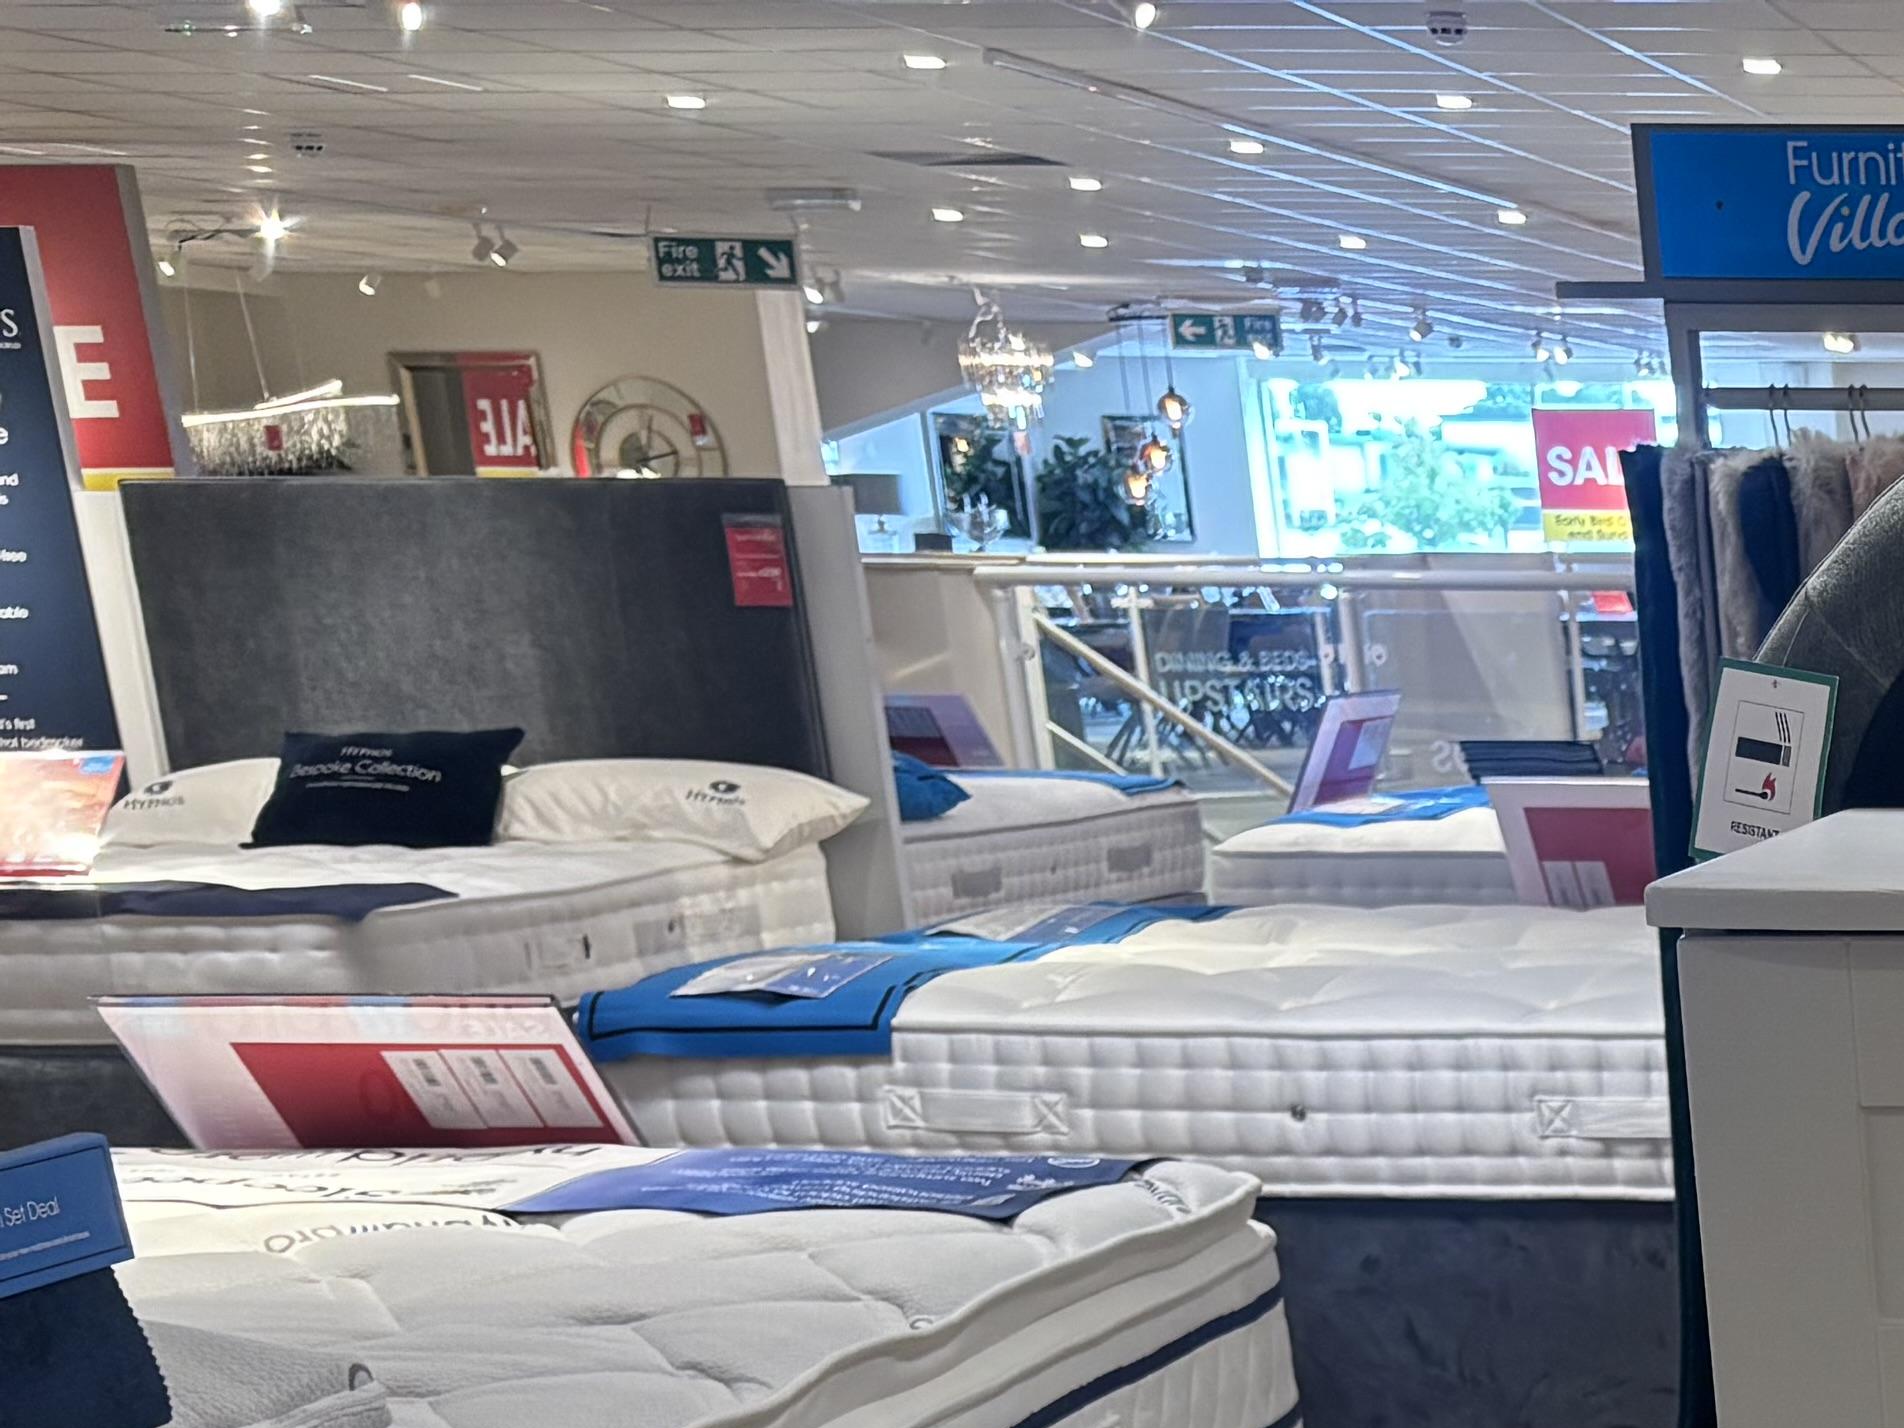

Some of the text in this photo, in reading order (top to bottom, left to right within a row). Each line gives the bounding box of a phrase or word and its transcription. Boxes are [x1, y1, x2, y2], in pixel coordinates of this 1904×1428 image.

[657, 241, 698, 259] Fire
[661, 260, 700, 277] exit
[1546, 445, 1625, 487] SAL
[1154, 651, 1234, 673] DINING
[1238, 651, 1256, 672] &
[1157, 676, 1315, 713] UPSTAIRS
[354, 759, 443, 783] Collection
[4, 1195, 60, 1227] Set Deal
